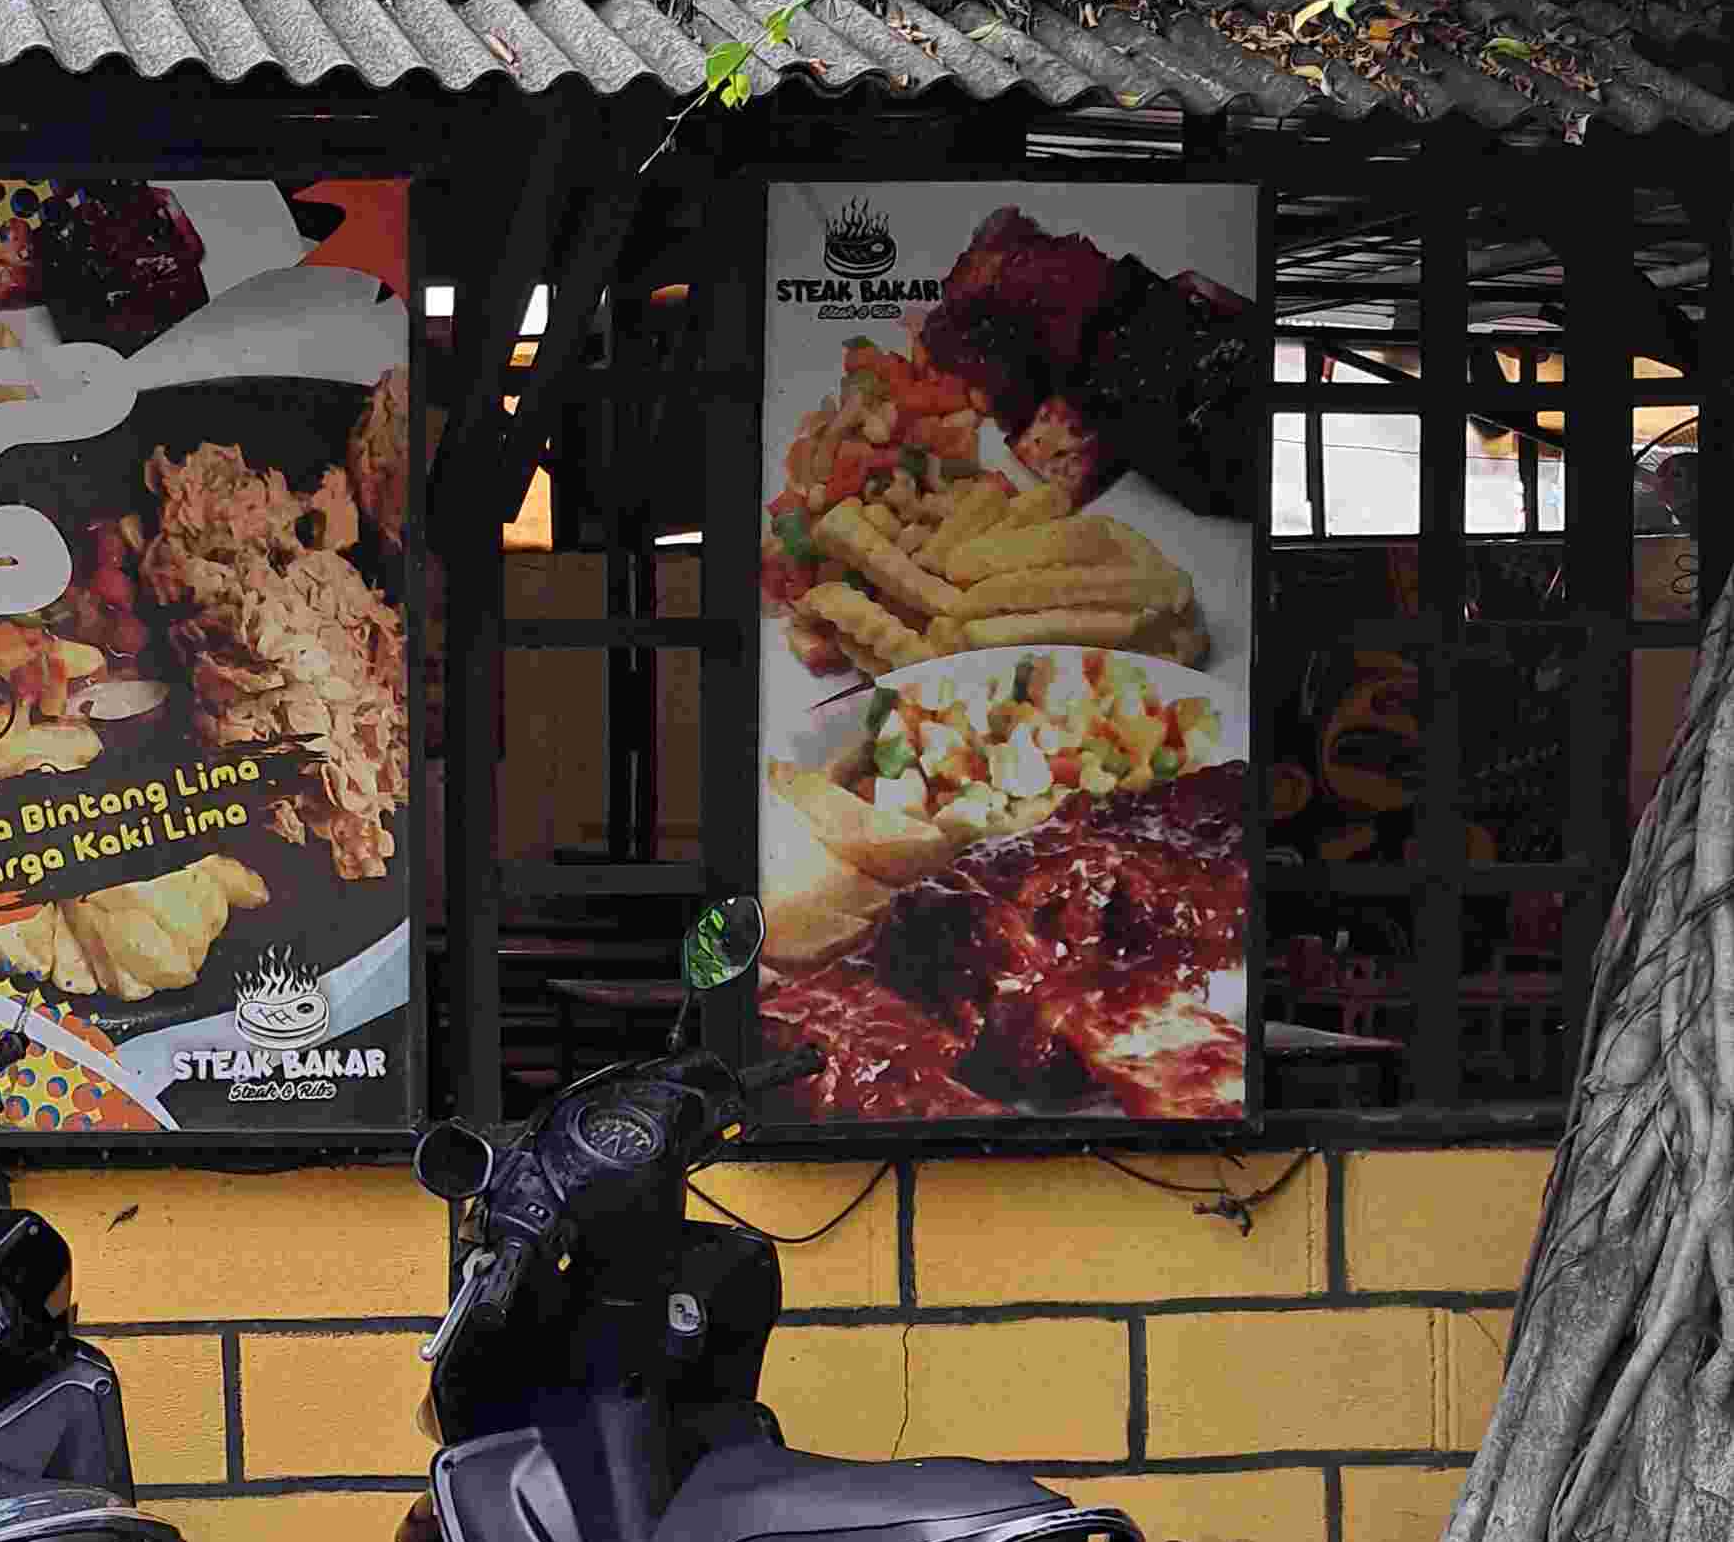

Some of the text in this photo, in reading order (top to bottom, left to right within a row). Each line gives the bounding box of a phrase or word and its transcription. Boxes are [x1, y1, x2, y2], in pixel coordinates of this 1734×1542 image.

[777, 279, 941, 303] STEAK BAKAR
[20, 780, 168, 834] Bintang
[175, 759, 260, 797] Lima
[72, 815, 155, 862] Kaki
[163, 803, 248, 842] Lima
[173, 1048, 387, 1081] STEAK BAKAR
[229, 1082, 277, 1101] Steak
[298, 1081, 337, 1099] Ribs
